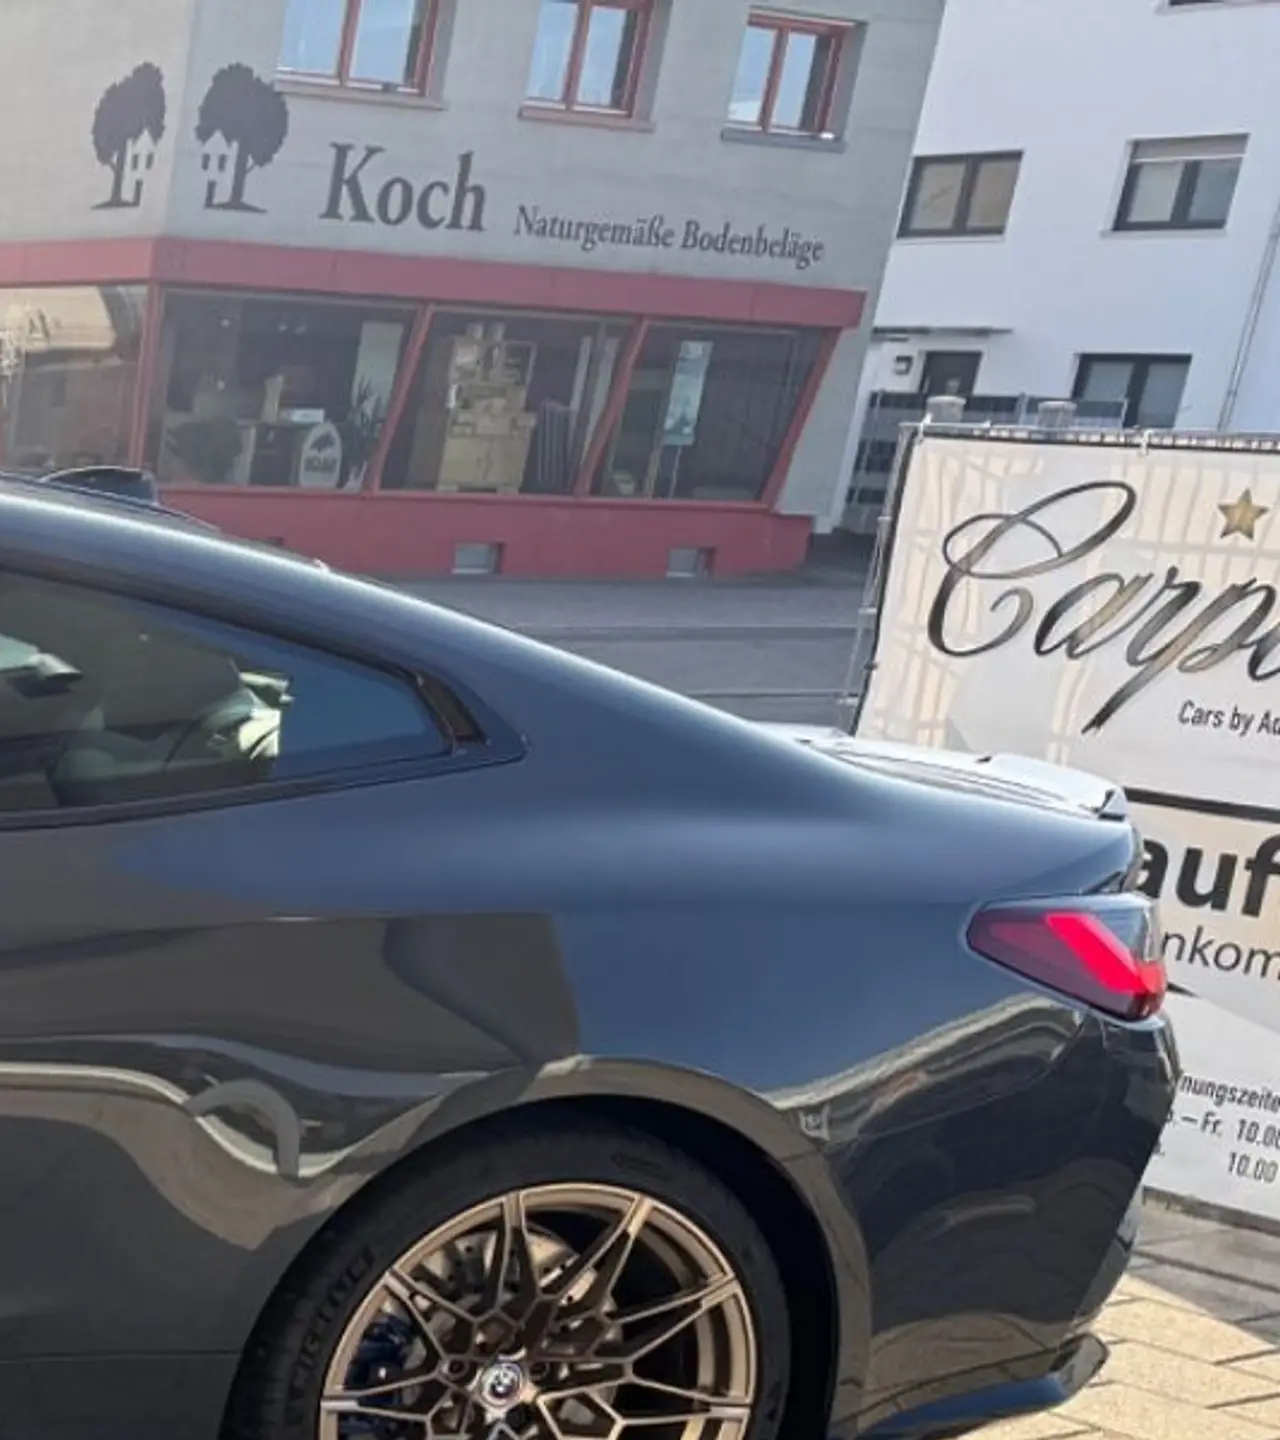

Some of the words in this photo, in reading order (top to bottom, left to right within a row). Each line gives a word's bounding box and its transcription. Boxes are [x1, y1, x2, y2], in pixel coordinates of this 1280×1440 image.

[319, 141, 487, 232] Koch
[513, 203, 675, 253] Naturgemäße
[681, 219, 824, 270] Bodenbeläge
[1178, 699, 1225, 729] Cars
[1228, 704, 1255, 737] by
